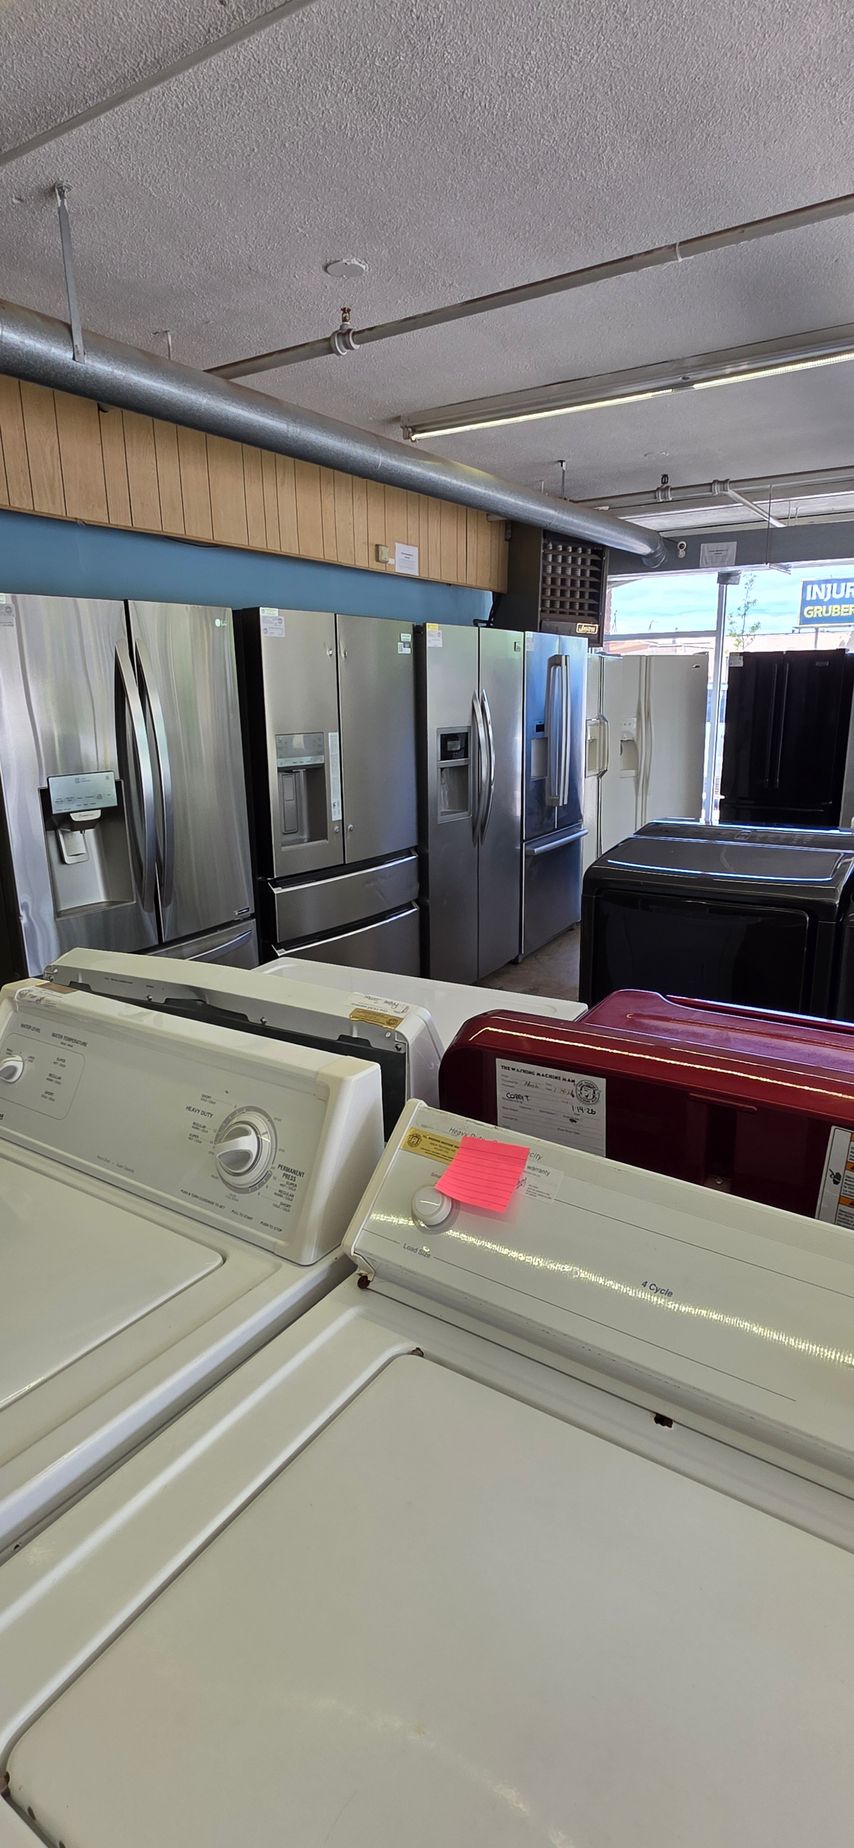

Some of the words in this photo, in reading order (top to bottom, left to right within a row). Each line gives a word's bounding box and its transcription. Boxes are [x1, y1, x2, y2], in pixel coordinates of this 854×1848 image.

[277, 1163, 305, 1179] PERMANENT
[282, 1172, 297, 1182] PRESS
[402, 1242, 418, 1253] Load
[417, 1248, 431, 1258] Size
[641, 1280, 648, 1288] 4
[649, 1283, 674, 1298] Cycle
